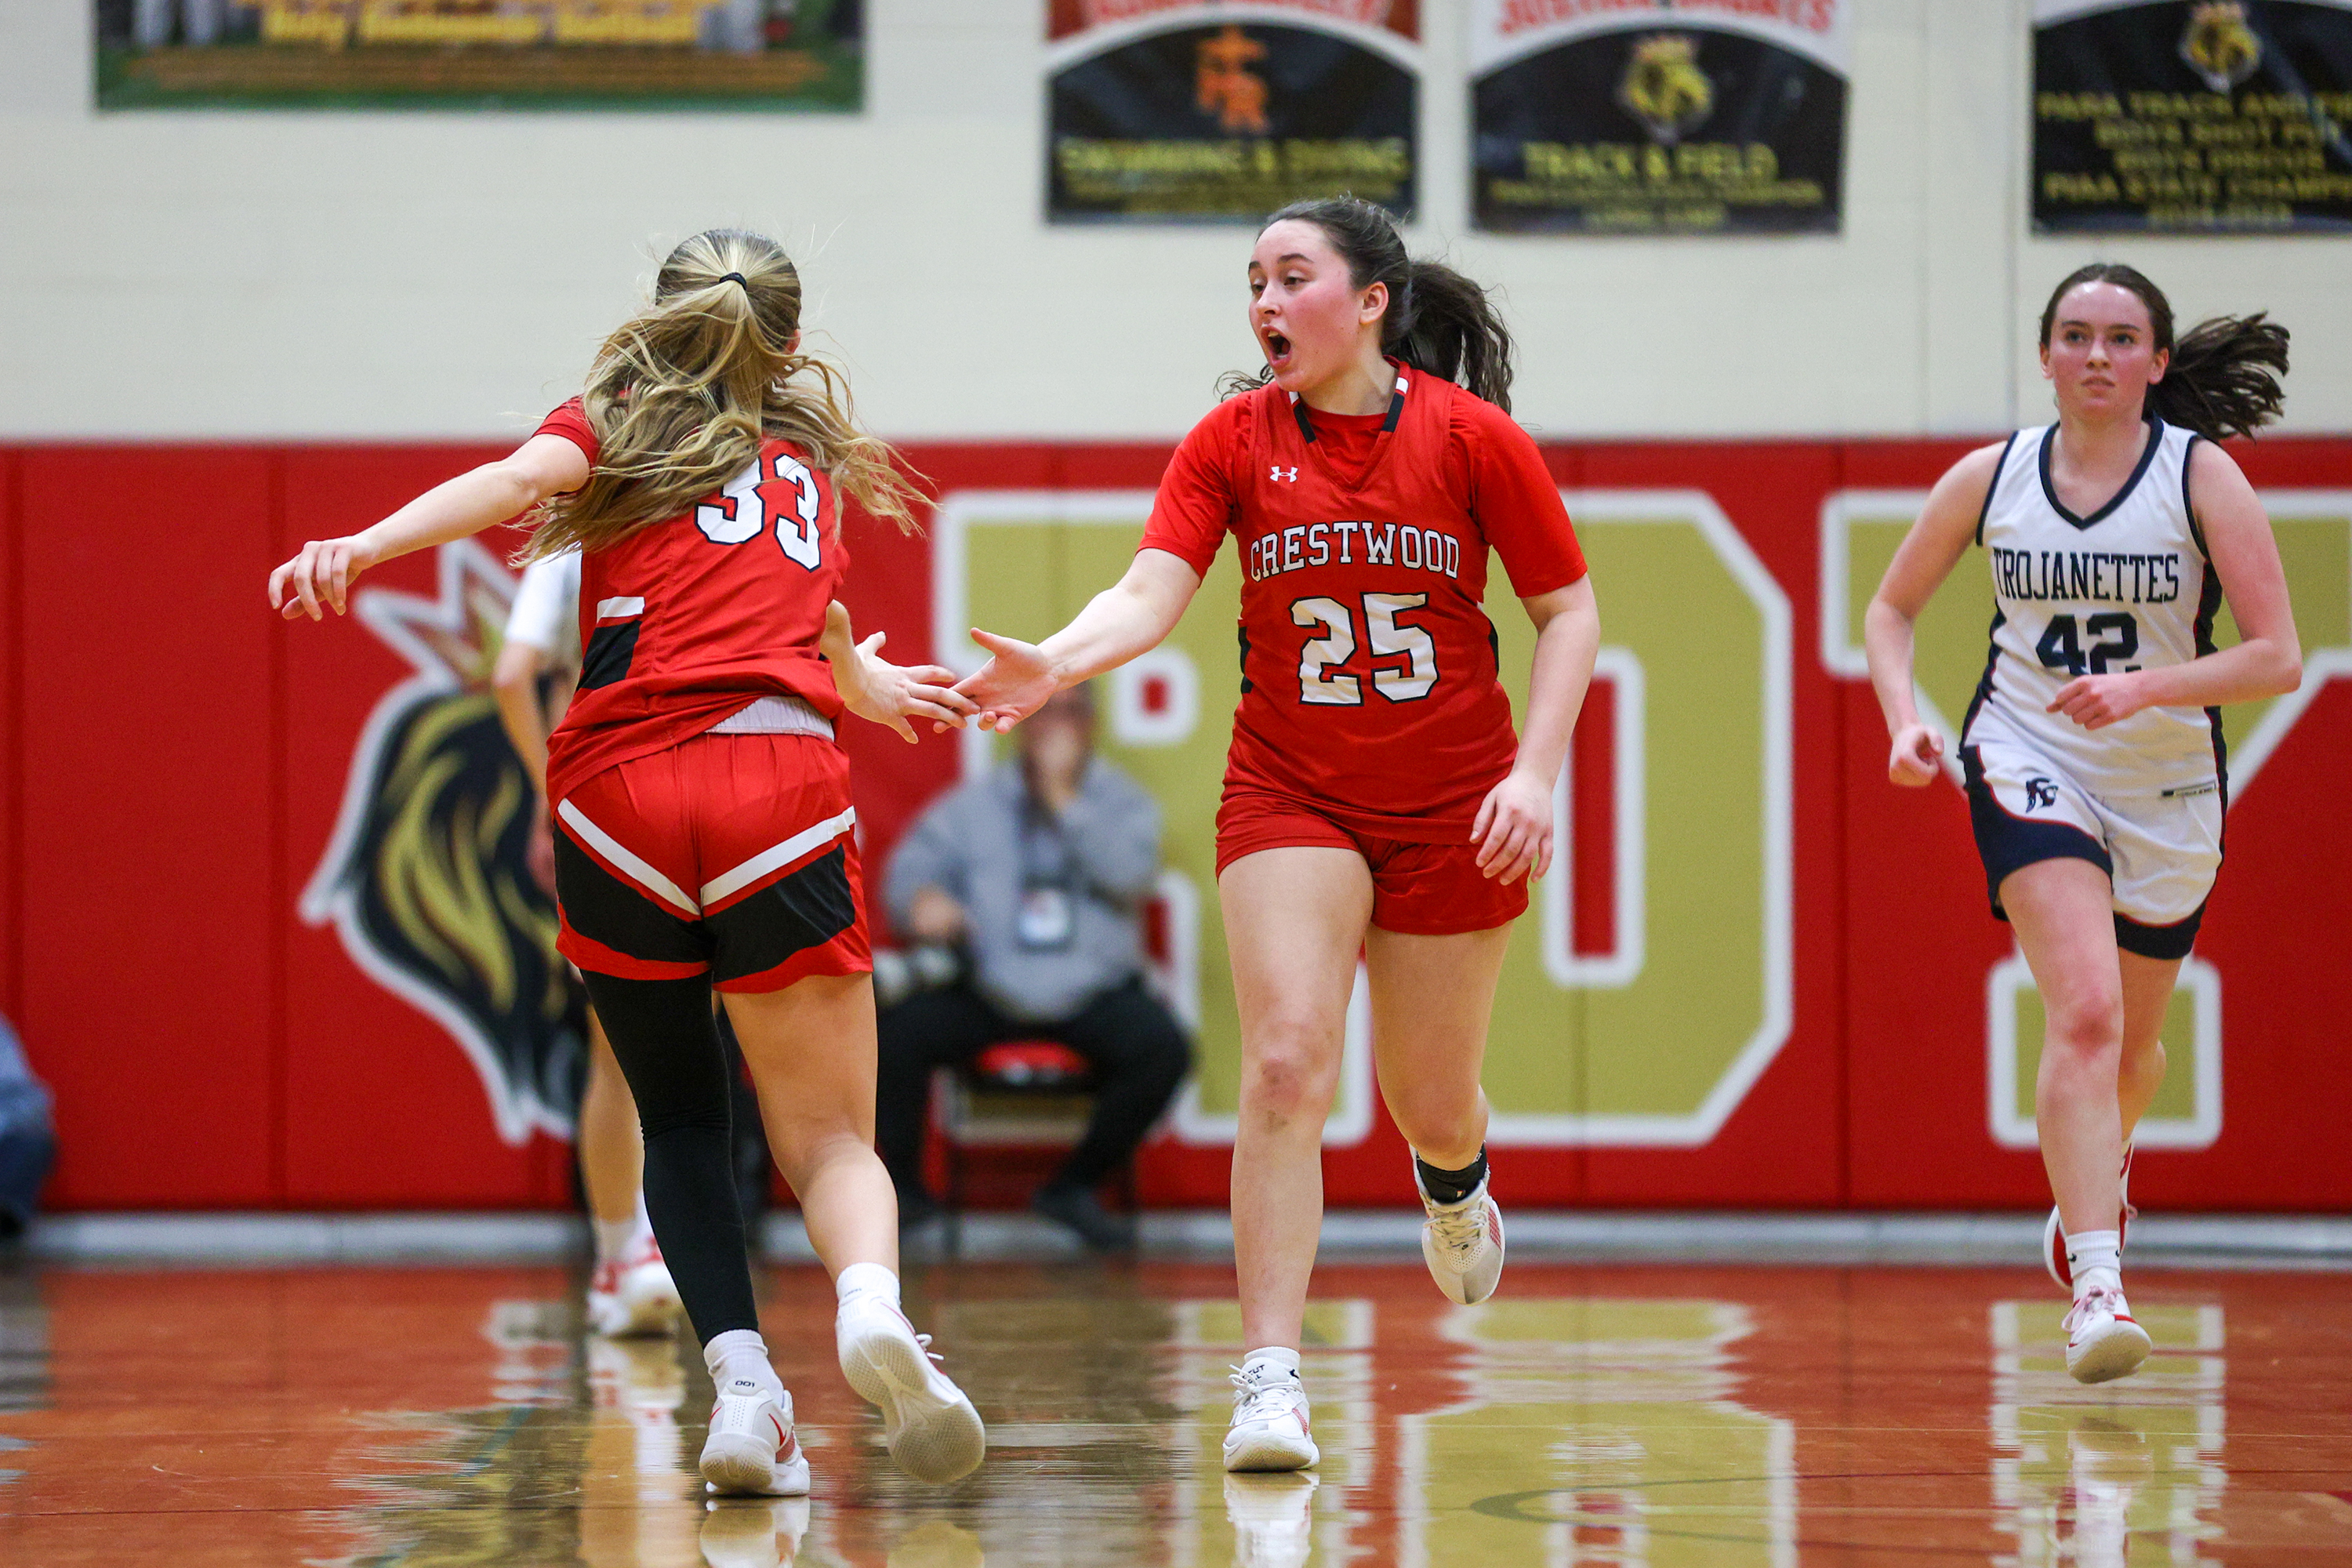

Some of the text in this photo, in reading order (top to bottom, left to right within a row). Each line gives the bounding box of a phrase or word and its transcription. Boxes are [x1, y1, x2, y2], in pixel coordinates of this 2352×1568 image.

[1521, 140, 1639, 181] TRACK
[1676, 140, 1780, 182] FIELD
[694, 452, 822, 573] 33
[1250, 520, 1461, 583] CRESTWOOD
[1993, 546, 2180, 604] TROJANETTES
[1288, 591, 1439, 706] 25
[2035, 611, 2143, 676] 42
